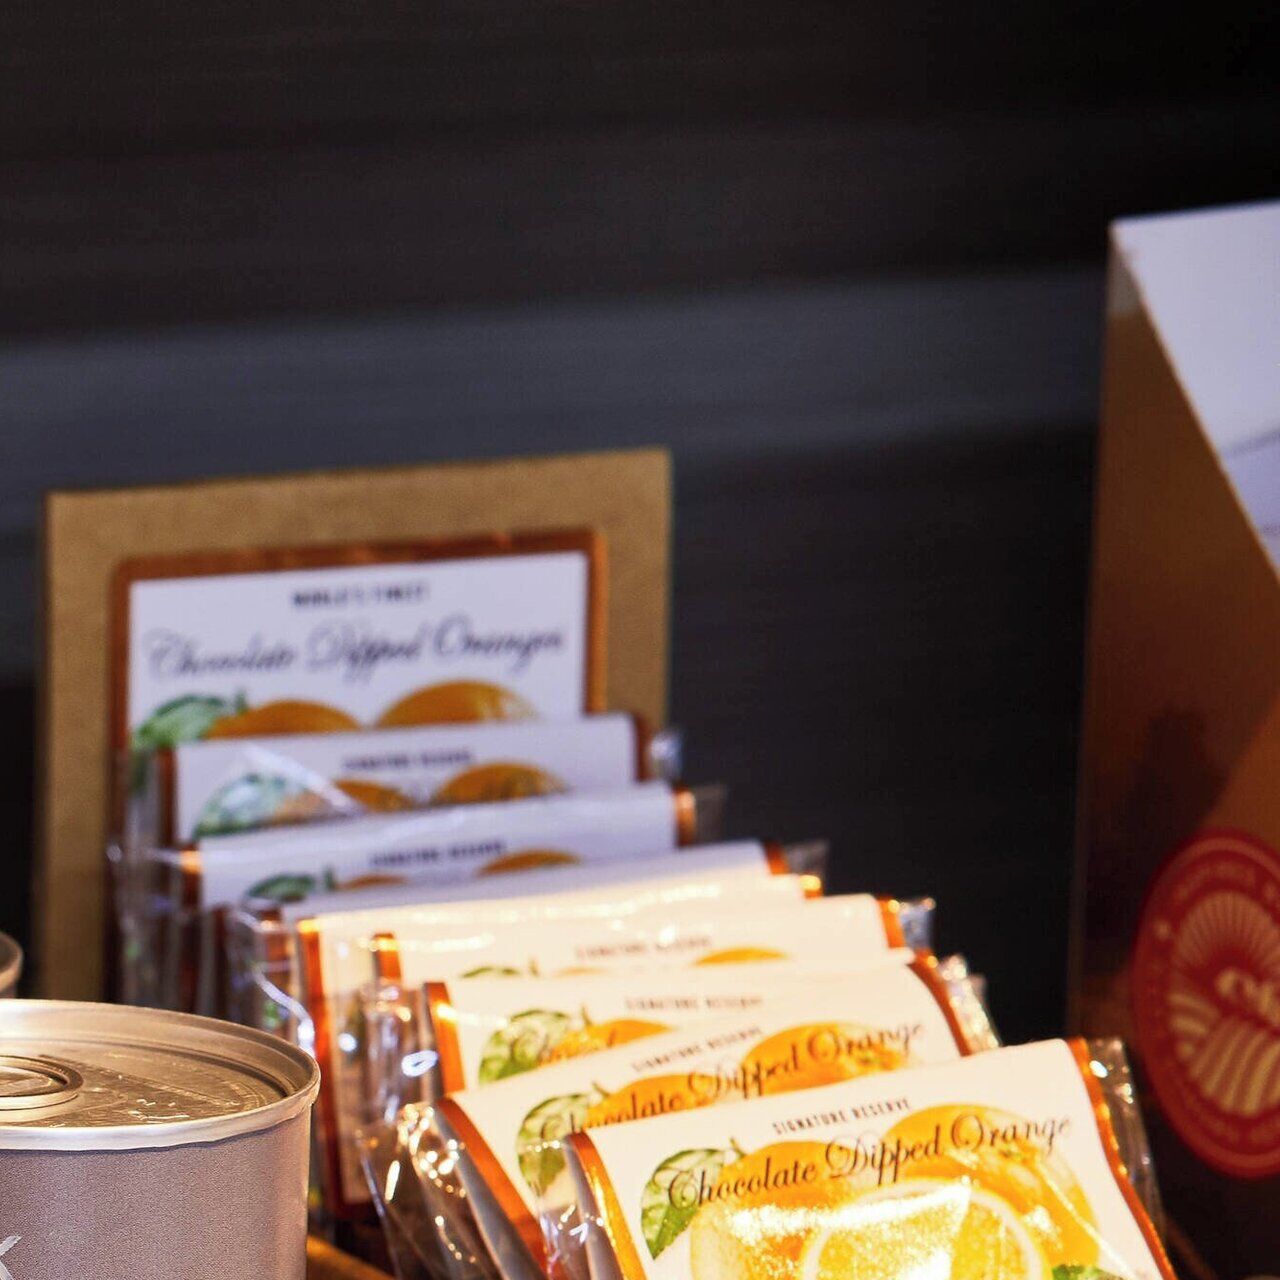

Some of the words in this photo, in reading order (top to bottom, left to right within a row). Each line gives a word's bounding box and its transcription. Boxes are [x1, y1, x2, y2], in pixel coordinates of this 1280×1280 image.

[772, 1109, 849, 1135] SIGNATURE
[851, 1097, 913, 1119] RESERVE
[665, 1156, 819, 1210] Chocolate
[824, 1124, 940, 1186] Dipped
[950, 1113, 1070, 1156] Orange
